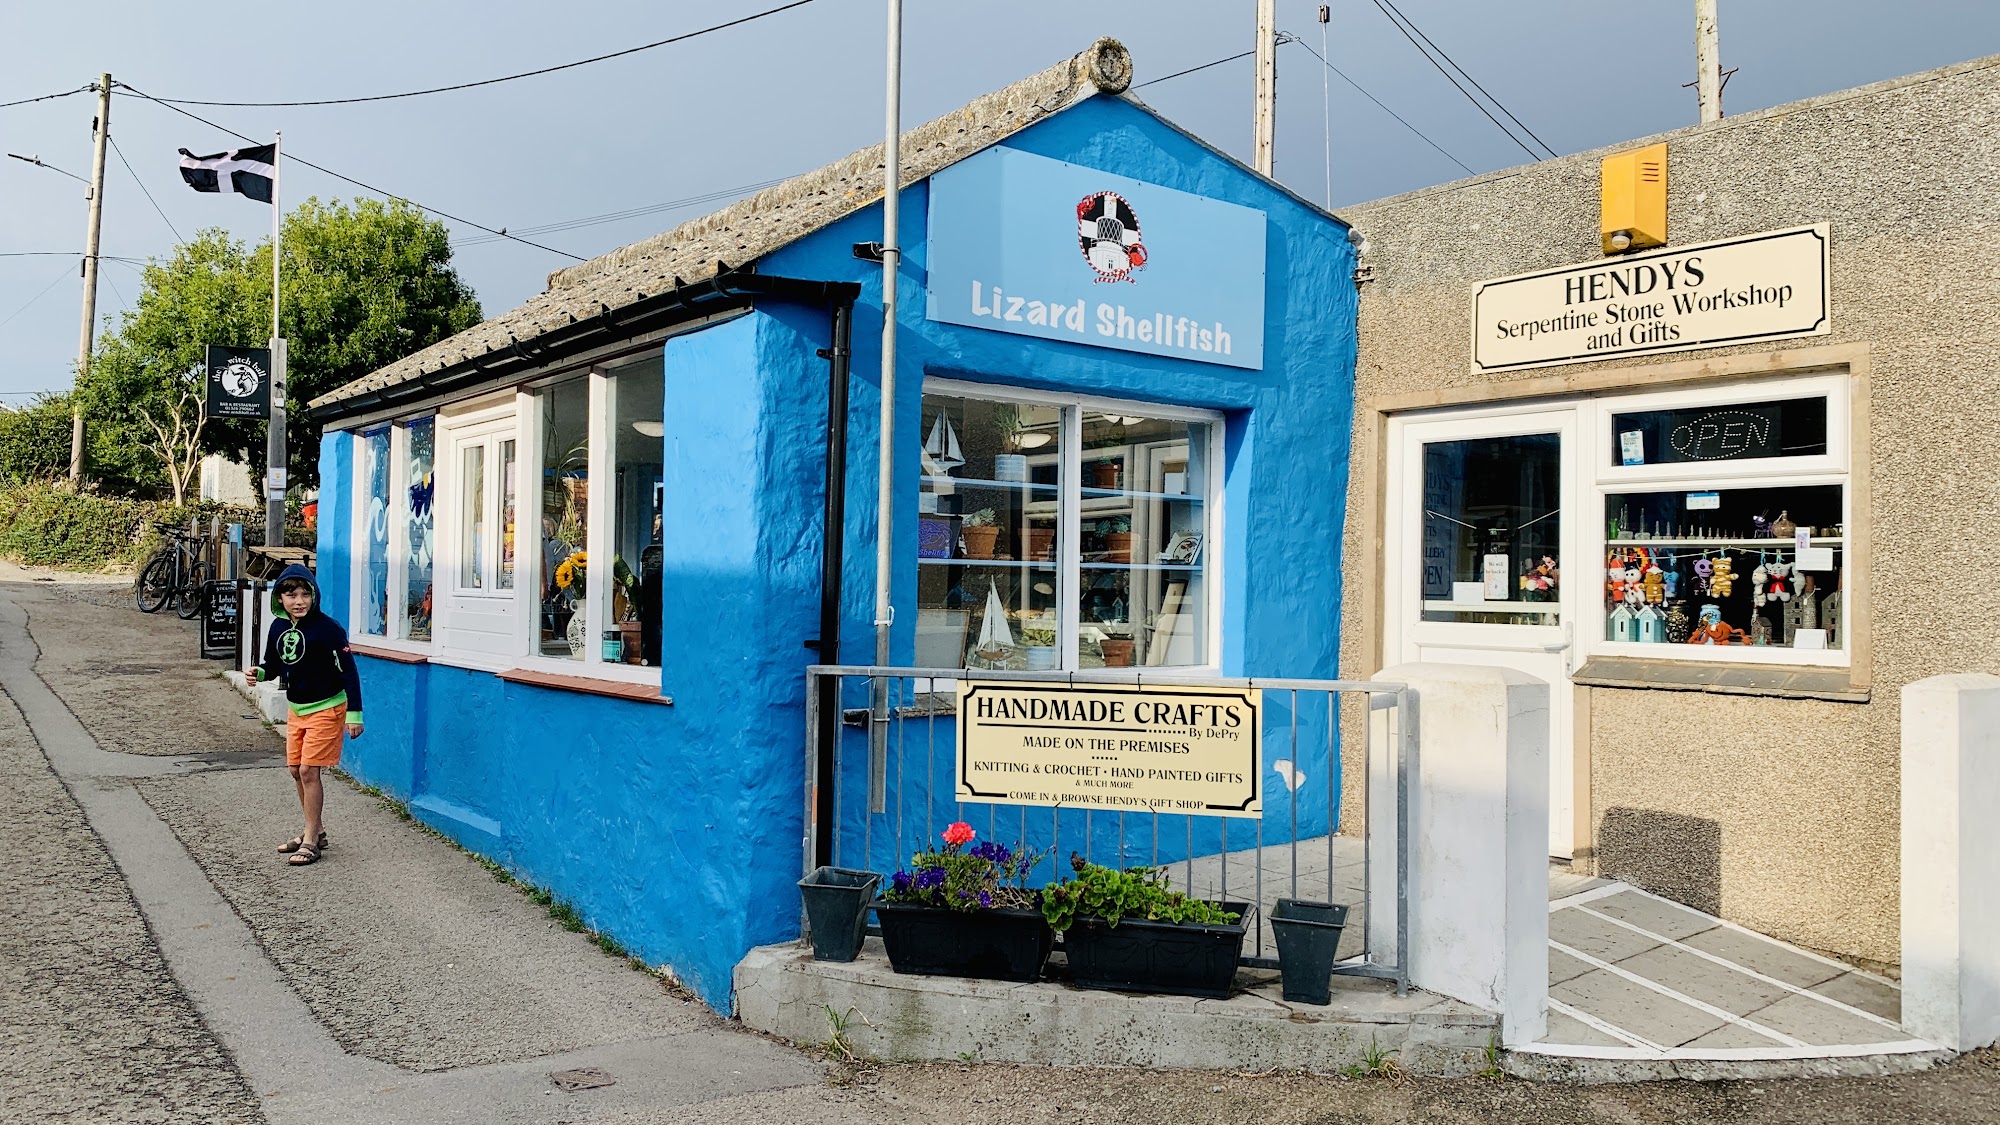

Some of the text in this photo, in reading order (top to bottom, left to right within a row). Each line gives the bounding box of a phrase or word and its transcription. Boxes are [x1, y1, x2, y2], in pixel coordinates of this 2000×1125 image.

[1565, 257, 1705, 306] HENDYS
[971, 280, 1231, 355] Lizard Shellfish
[1497, 284, 1793, 341] Serpentine Stone Workshop
[1586, 321, 1681, 351] and Gifts
[227, 355, 252, 366] witch
[251, 362, 267, 377] ball
[1670, 420, 1771, 450] OPEN
[976, 696, 1241, 728] HANDMADE CRAFTS
[1022, 736, 1190, 754] MADE ON THE PREMISES
[1188, 727, 1240, 741] By DePry
[974, 761, 1243, 784] KNITTING & CROCHET HAND PAINTED GIFTS
[1075, 779, 1134, 789] & MUCH MORE
[1009, 791, 1204, 810] COME IN & BROWSE HENDY'S GIFT SHOP
